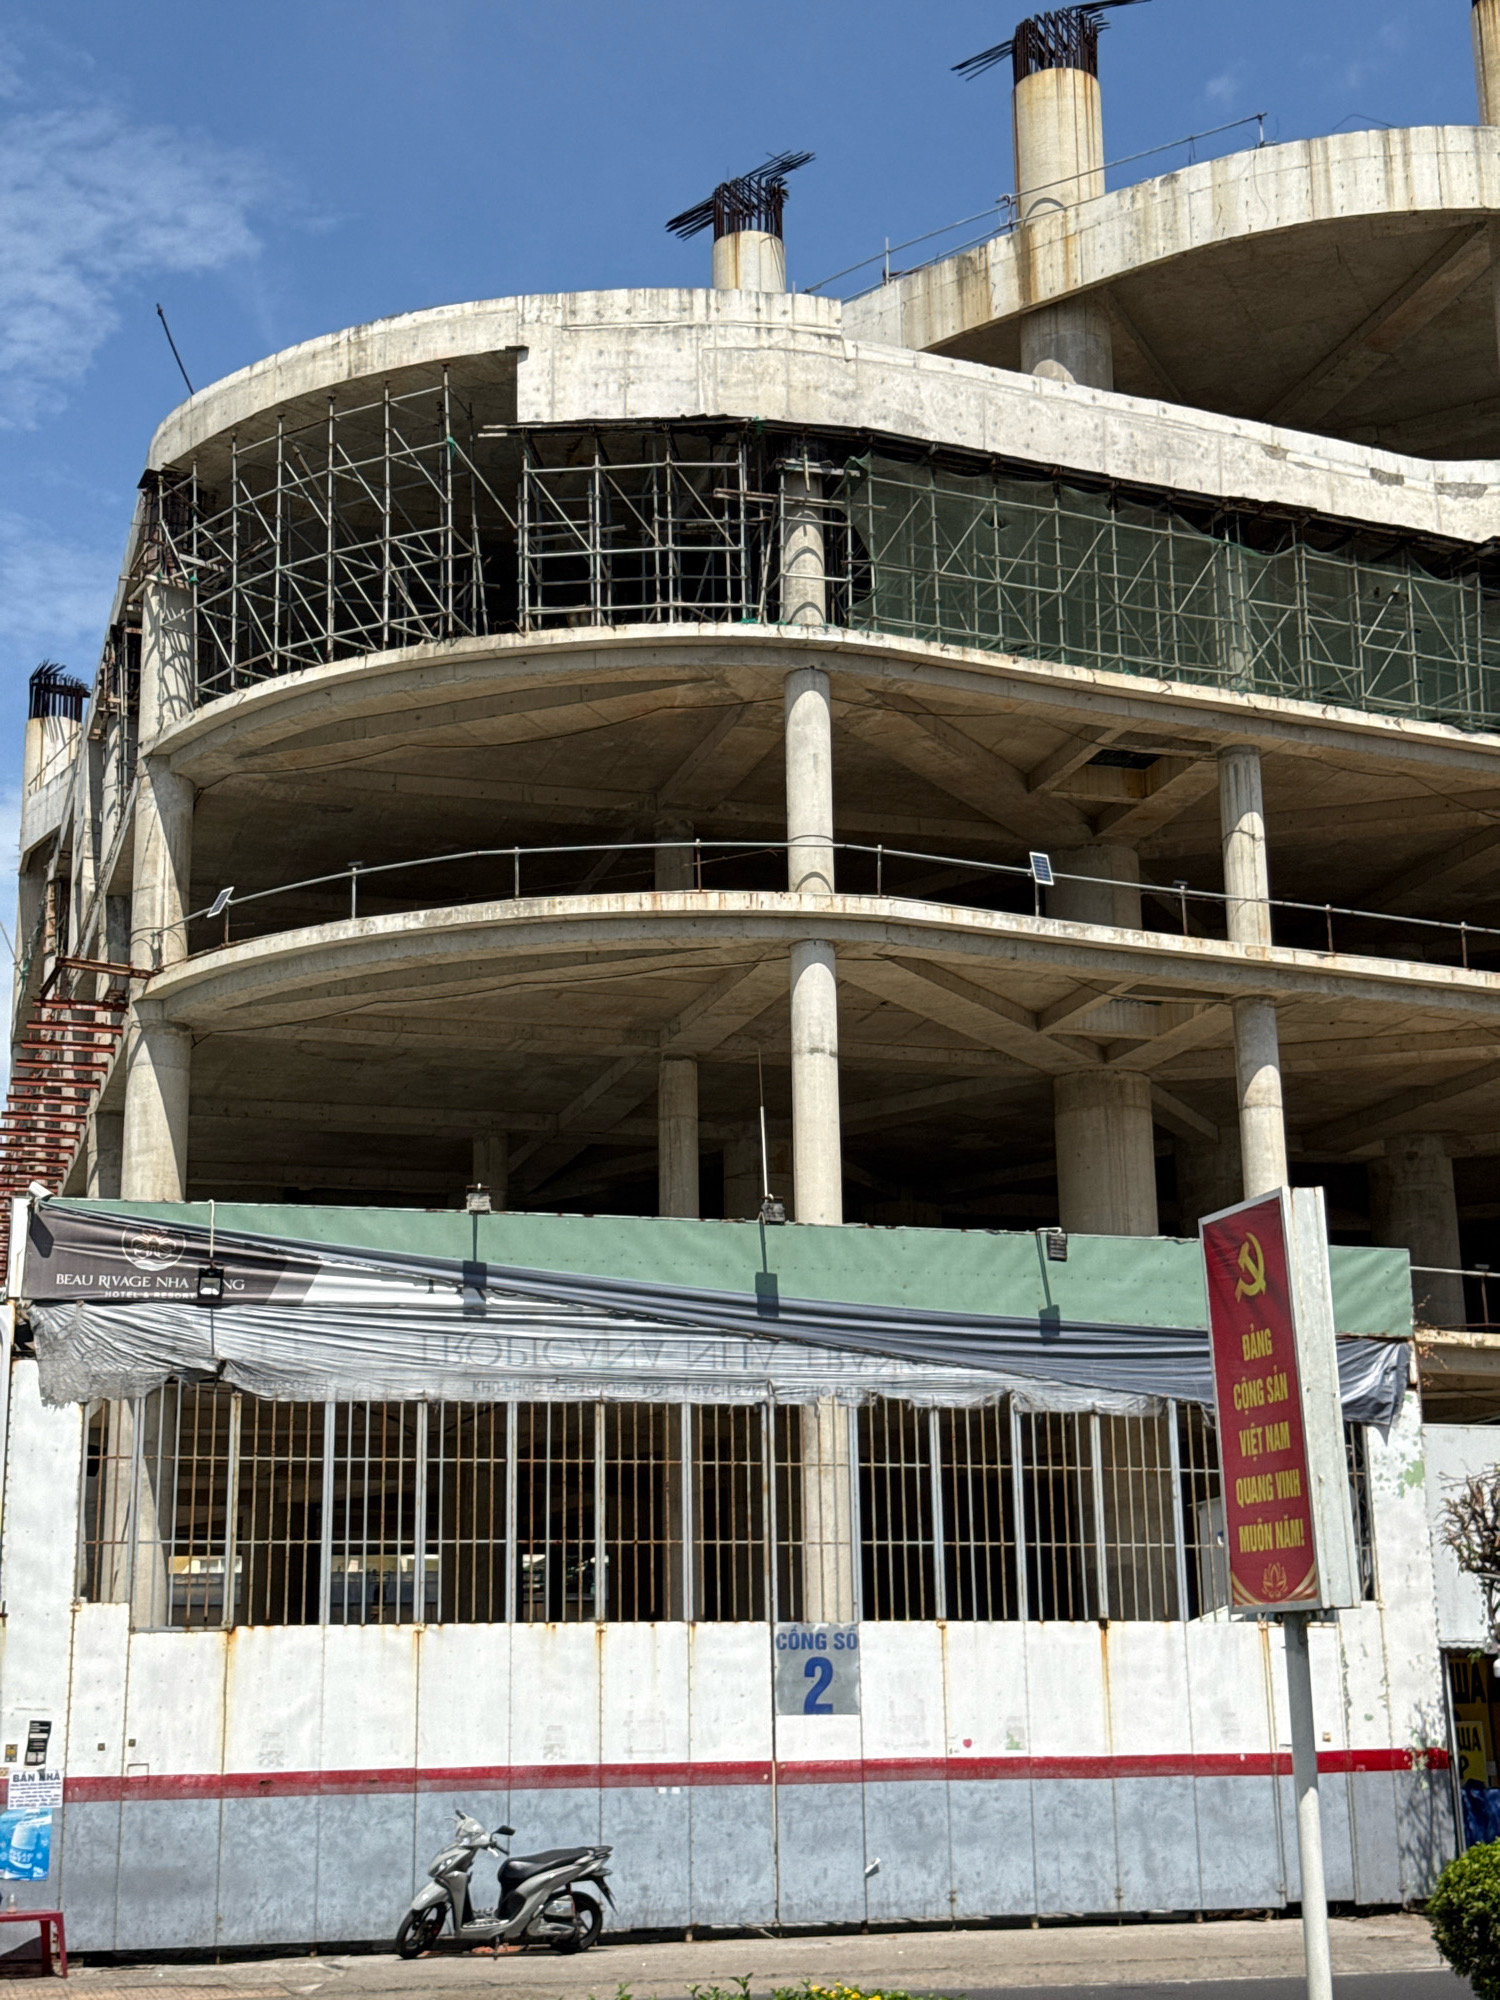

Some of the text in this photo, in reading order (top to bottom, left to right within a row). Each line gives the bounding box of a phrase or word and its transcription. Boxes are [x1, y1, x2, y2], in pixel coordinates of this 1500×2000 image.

[56, 1273, 93, 1286] BEAU
[98, 1275, 151, 1289] RIVAGE
[156, 1276, 189, 1289] NHA
[105, 1291, 138, 1299] HOTEL
[154, 1291, 196, 1300] RESORT
[1242, 1323, 1273, 1361] ĐẢNG
[1233, 1365, 1289, 1415] CỘNG SẢN
[1239, 1421, 1291, 1461] VIỆT NAM
[1235, 1468, 1301, 1508] QUANG VINH
[1238, 1514, 1305, 1553] MUÔN NĂM!
[804, 1656, 834, 1715] 2
[13, 1771, 35, 1783] BÁN
